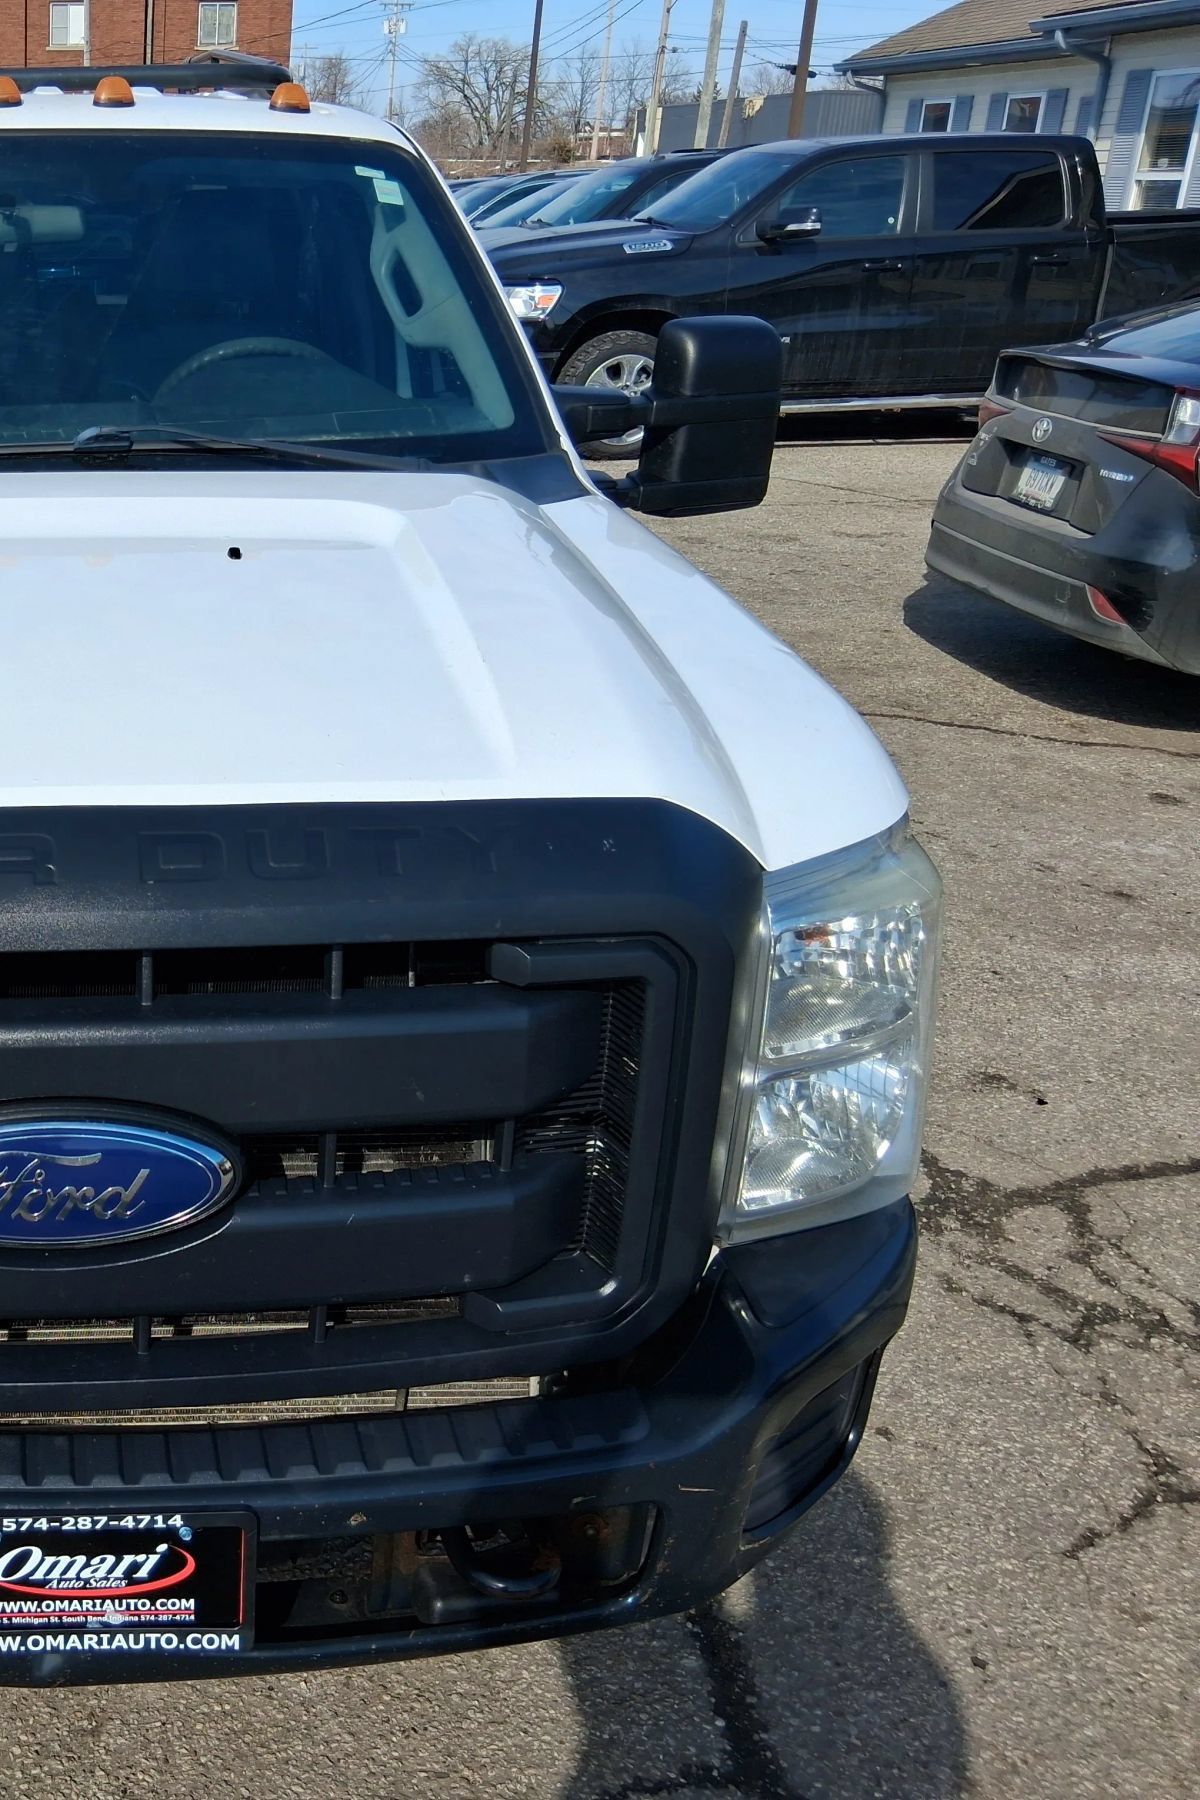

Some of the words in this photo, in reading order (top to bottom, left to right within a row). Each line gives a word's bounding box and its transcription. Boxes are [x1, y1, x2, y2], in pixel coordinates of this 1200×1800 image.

[137, 825, 520, 884] DUTY
[2, 1514, 183, 1532] 574-287-4714
[45, 1578, 82, 1590] Auto
[85, 1577, 128, 1589] Sales
[11, 1616, 48, 1624] Michigan
[62, 1615, 86, 1623] South
